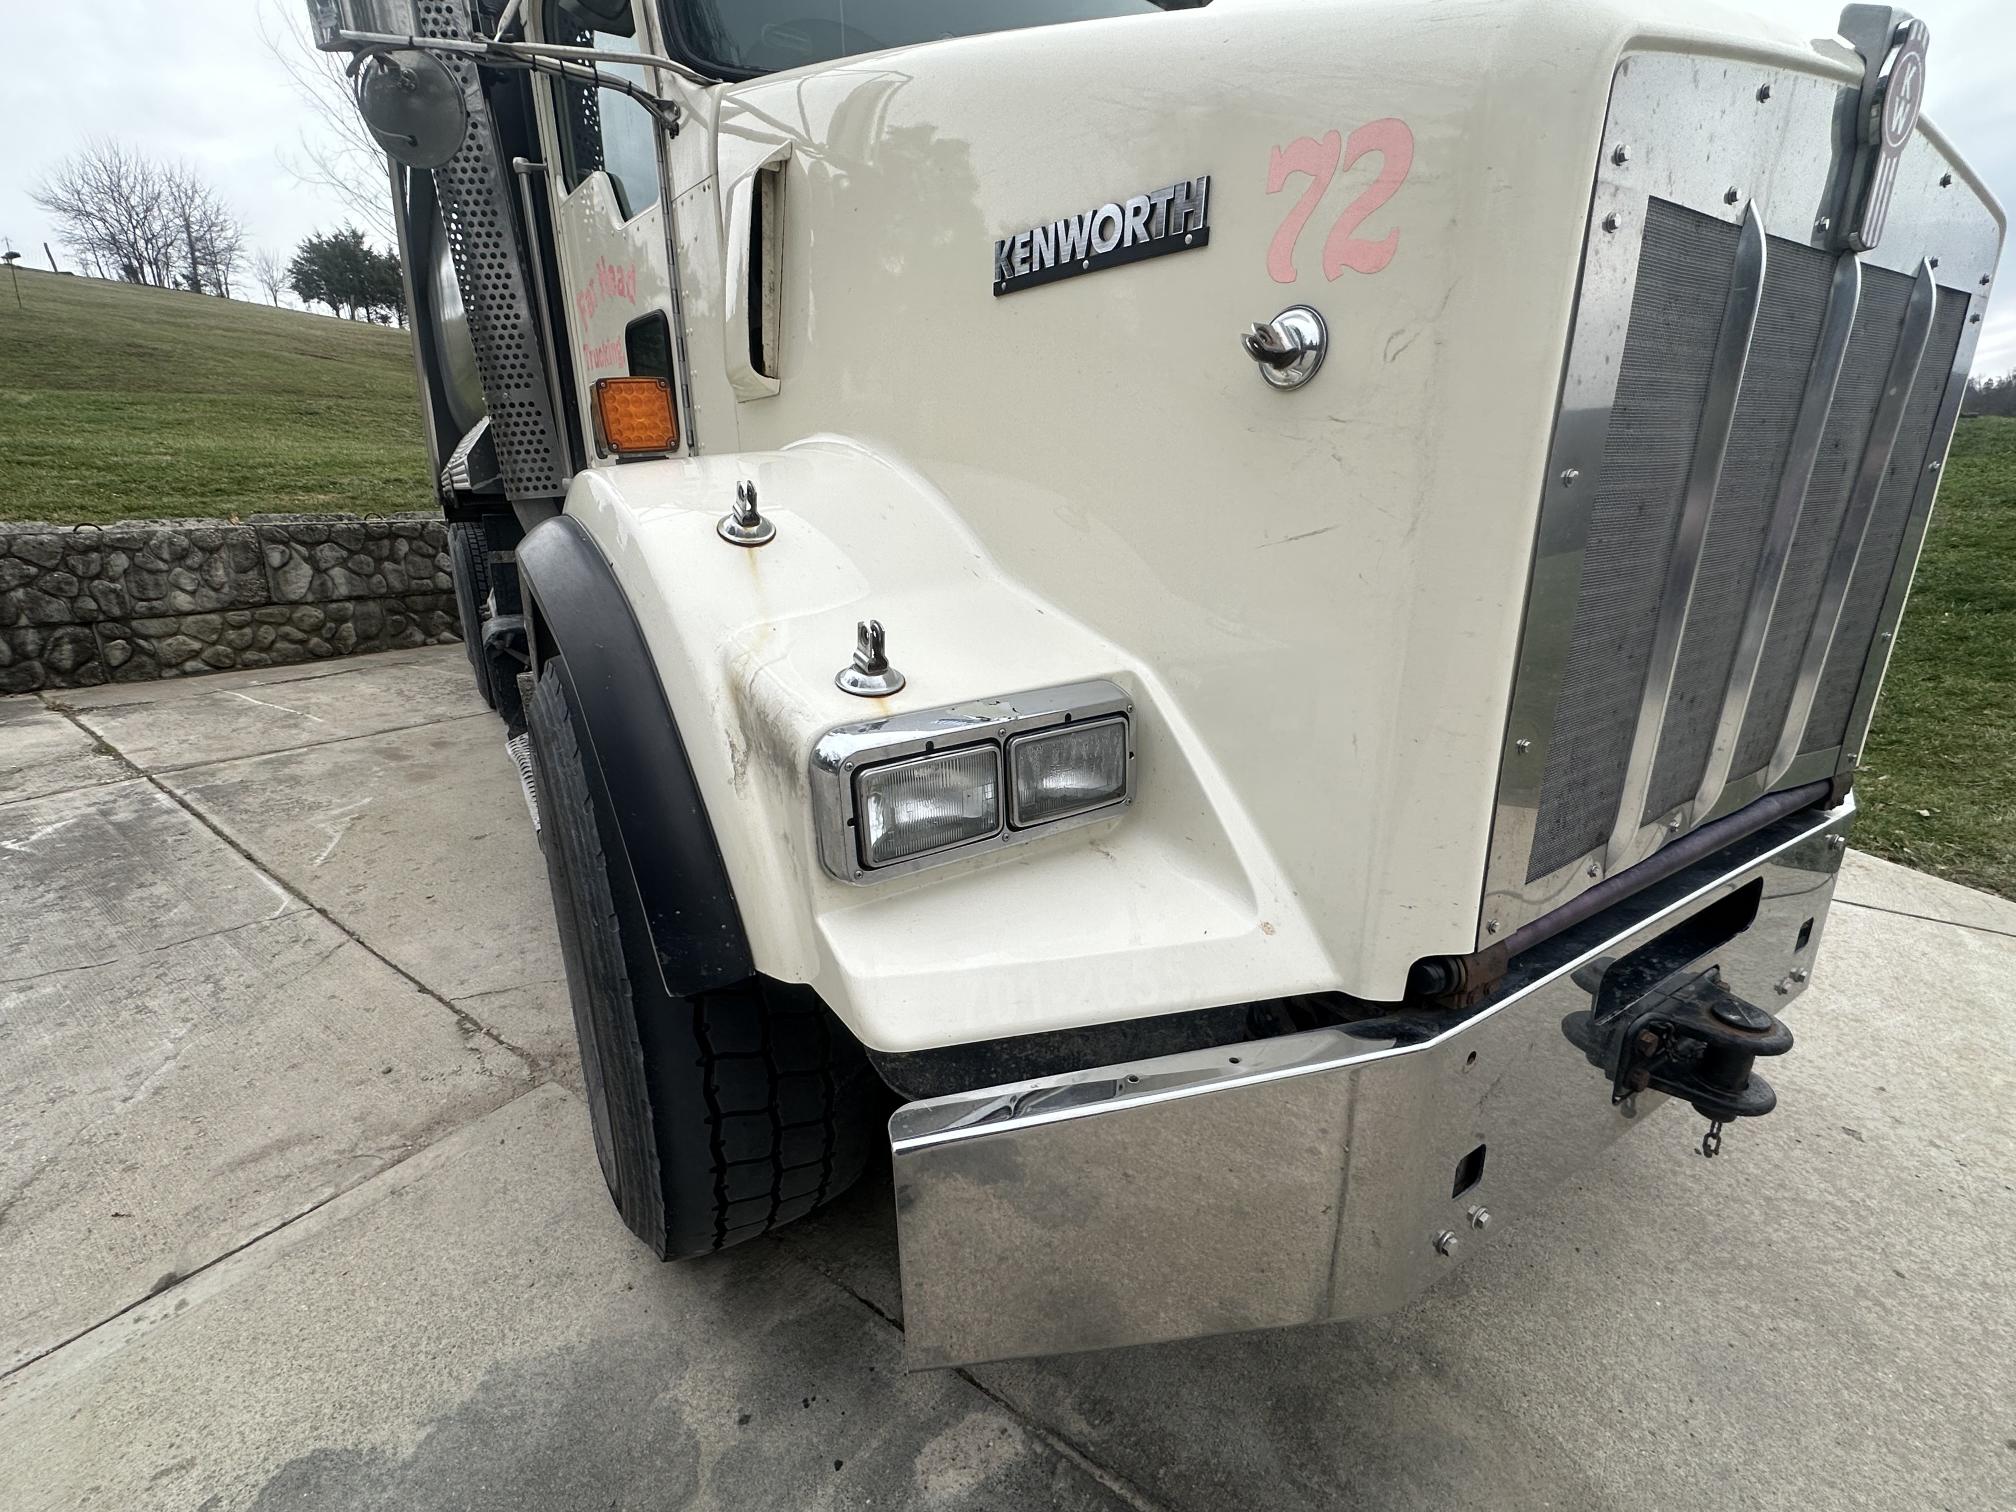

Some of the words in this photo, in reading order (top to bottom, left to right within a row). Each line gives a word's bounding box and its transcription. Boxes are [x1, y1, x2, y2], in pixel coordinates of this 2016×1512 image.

[994, 175, 1210, 281] KENWORTH
[1266, 117, 1414, 284] 72
[582, 336, 625, 371] Trucking
